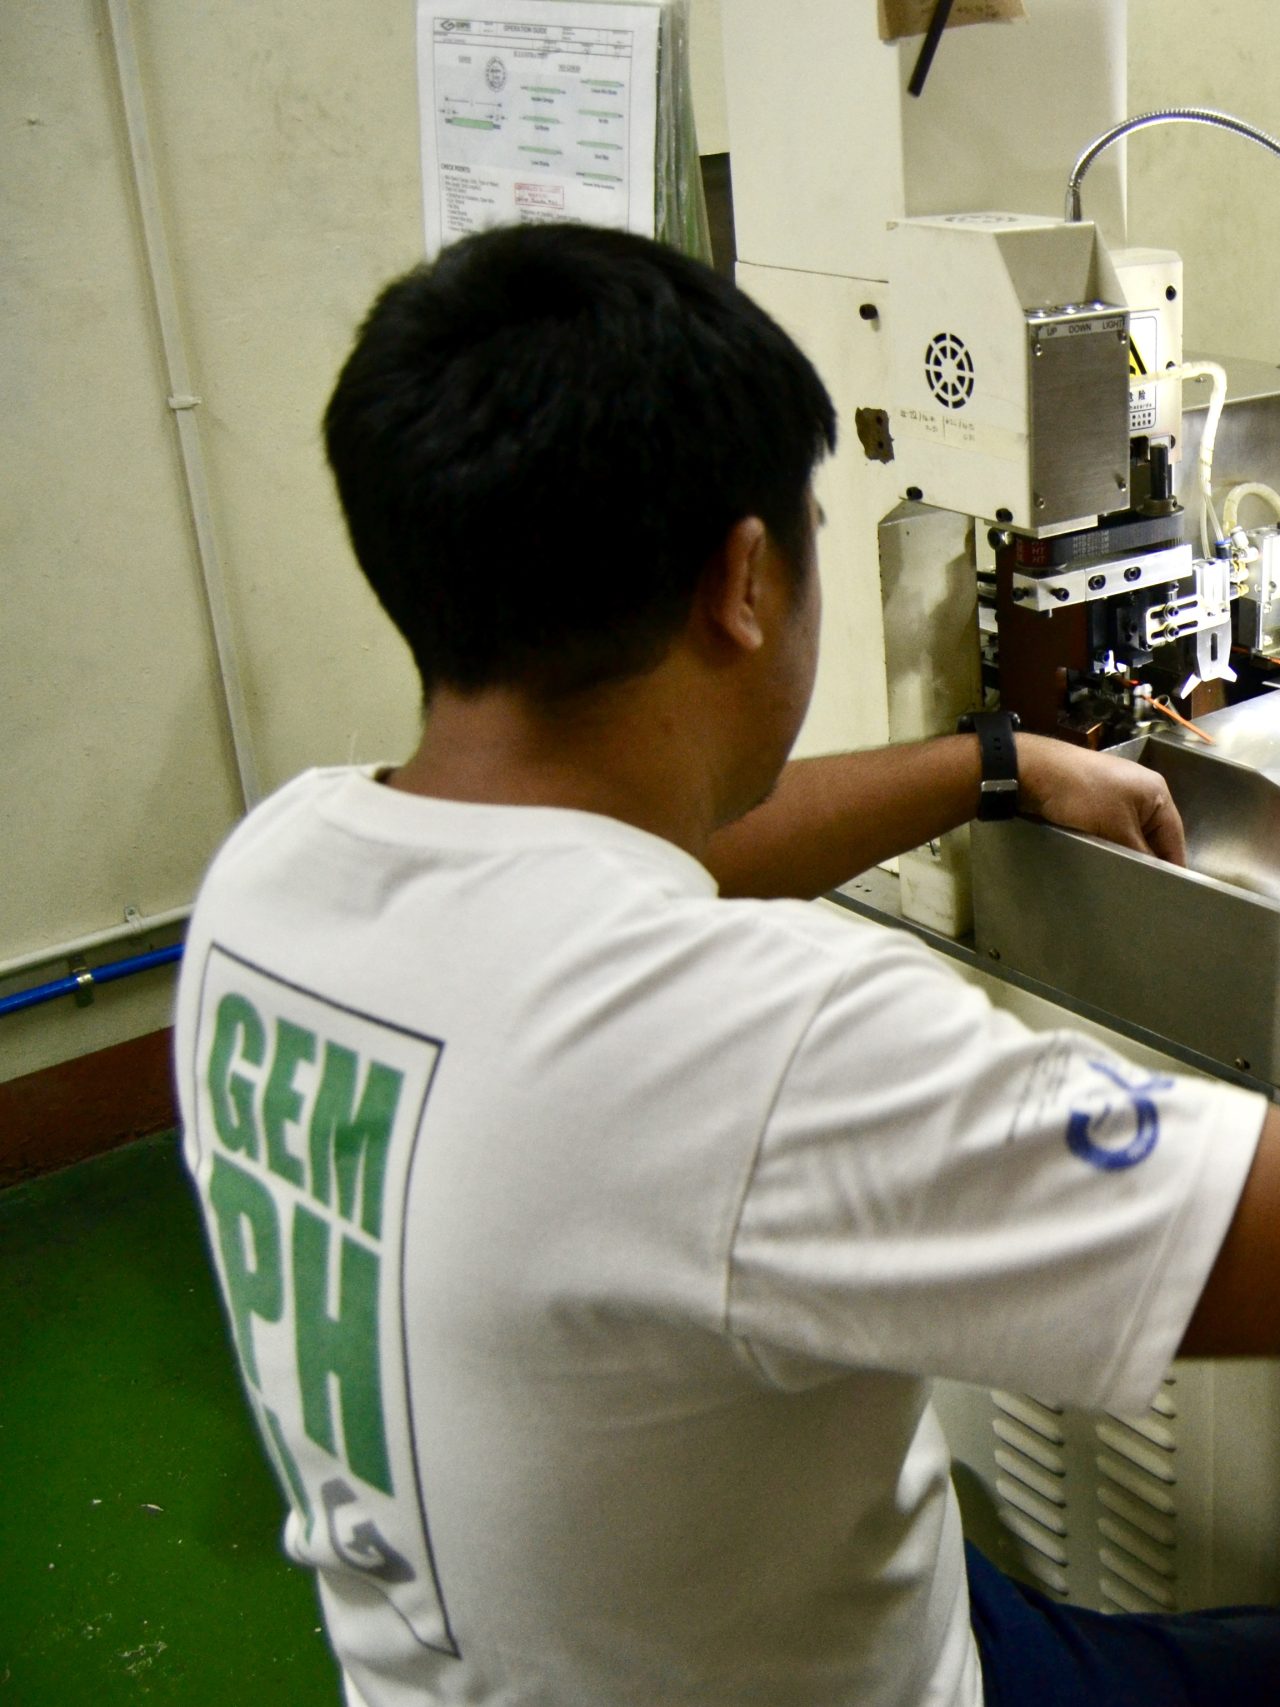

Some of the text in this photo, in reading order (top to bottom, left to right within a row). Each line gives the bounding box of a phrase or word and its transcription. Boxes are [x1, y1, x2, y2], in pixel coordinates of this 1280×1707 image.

[1046, 319, 1124, 337] UP DOWN LIGHT
[207, 992, 405, 1242] GEM
